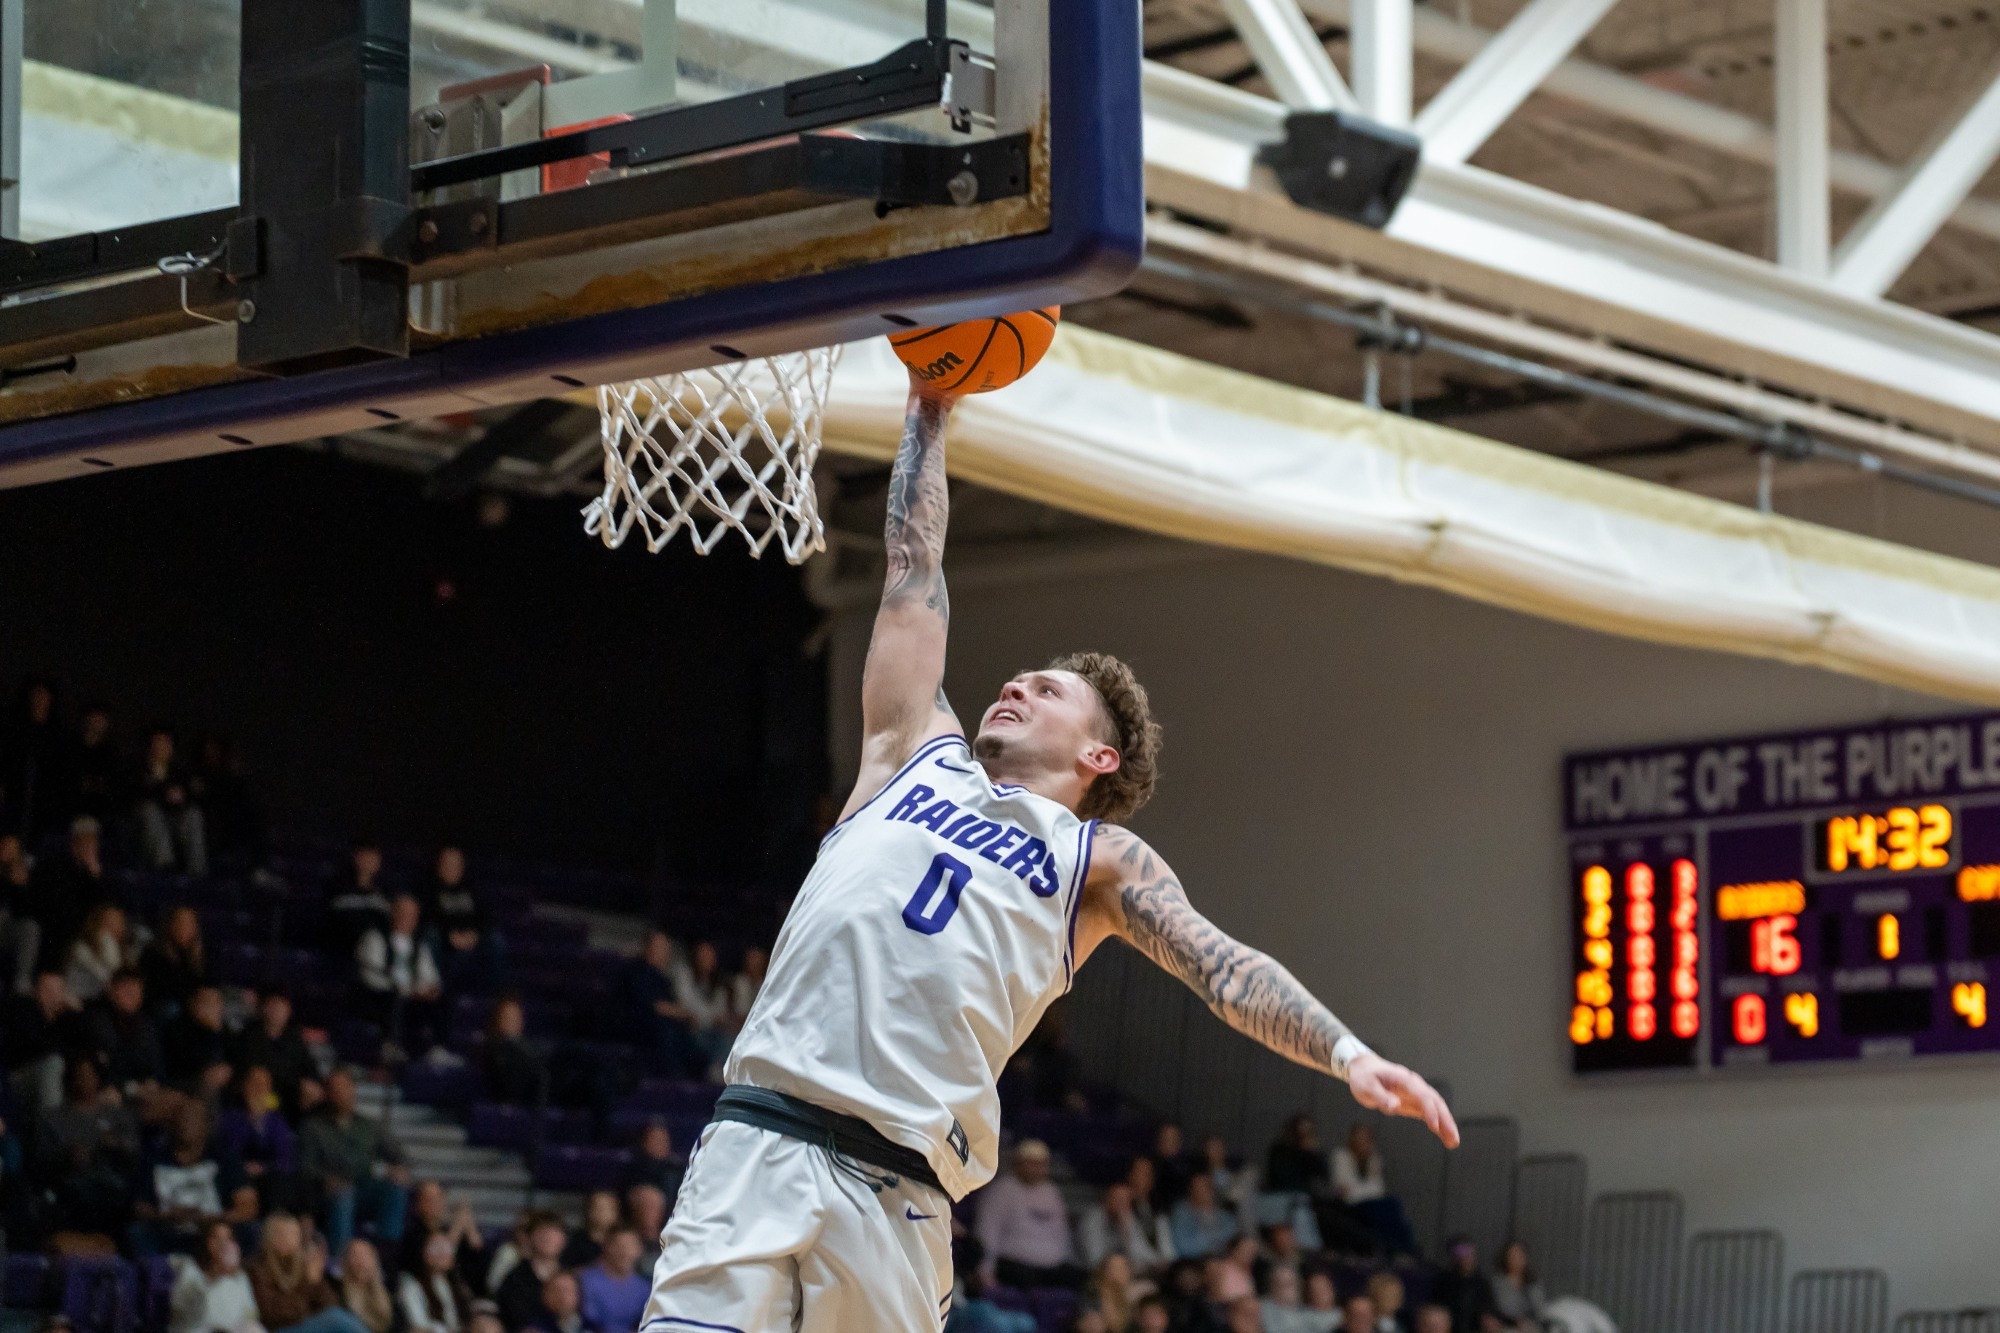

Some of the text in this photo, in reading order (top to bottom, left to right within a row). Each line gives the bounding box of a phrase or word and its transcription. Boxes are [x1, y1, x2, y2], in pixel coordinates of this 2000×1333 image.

[905, 351, 965, 381] lson
[1573, 720, 2000, 822] HOME OF THE PURPLE
[884, 783, 1059, 898] RAIDERS
[1827, 804, 1953, 872] 14:32
[901, 852, 973, 935] 0
[1751, 913, 1802, 976] 16
[1877, 913, 1900, 960] 1
[1732, 992, 1767, 1045] 0
[1784, 991, 1819, 1038] 4
[1952, 981, 1987, 1028] 4
